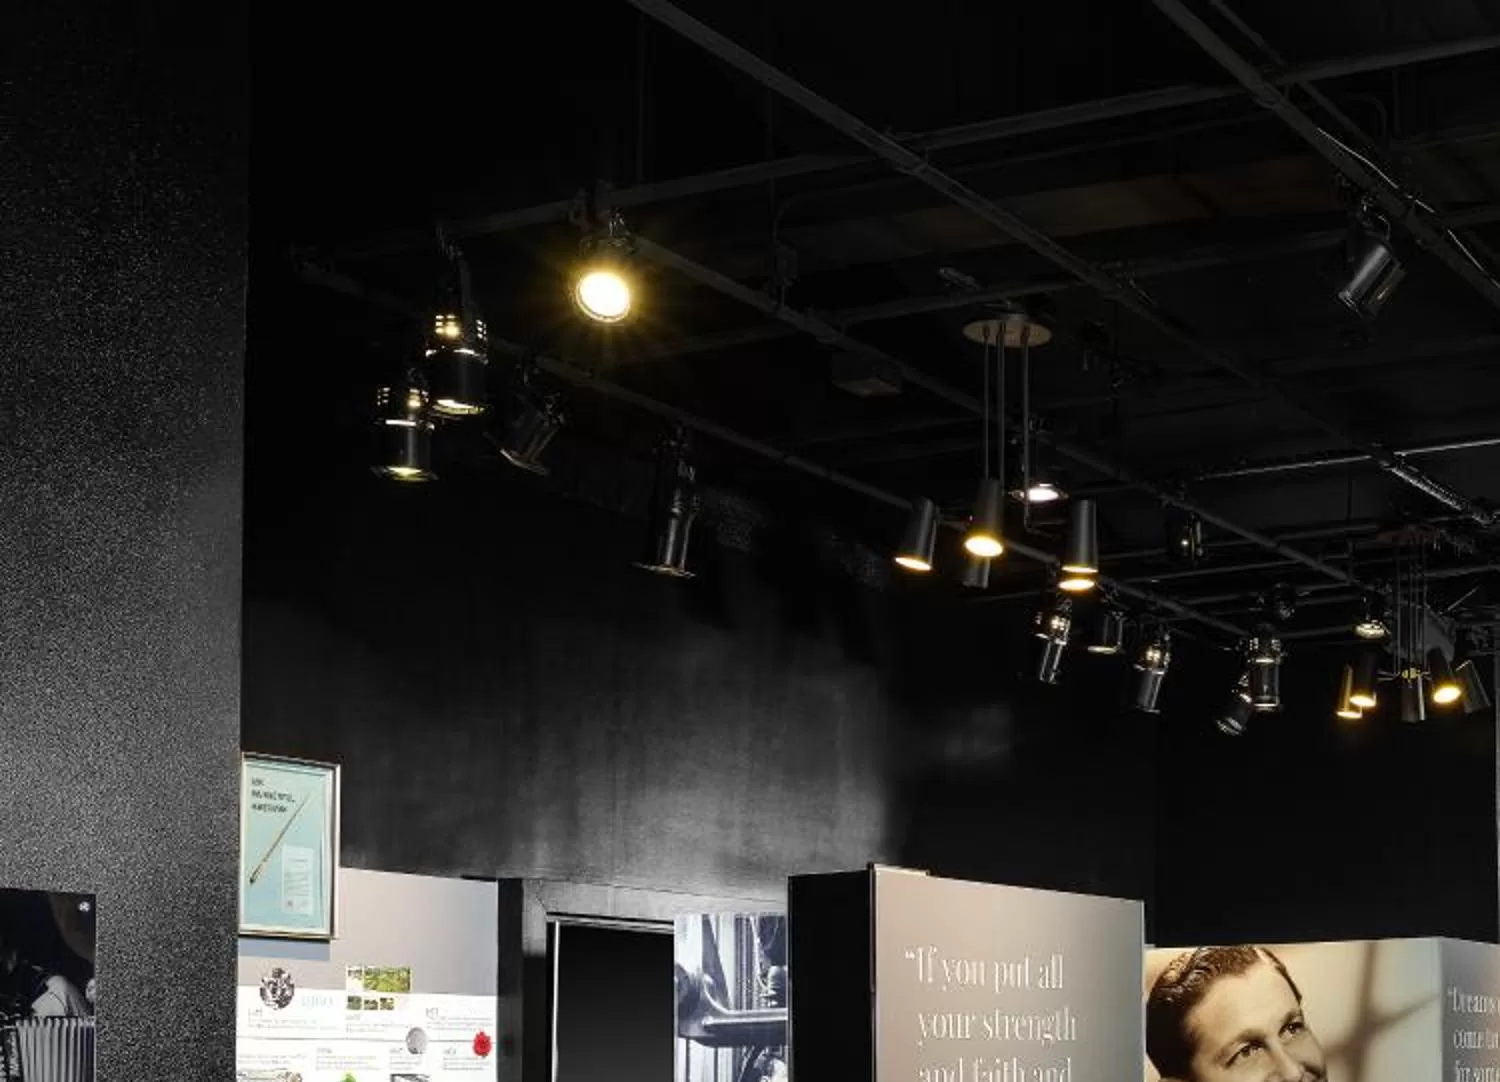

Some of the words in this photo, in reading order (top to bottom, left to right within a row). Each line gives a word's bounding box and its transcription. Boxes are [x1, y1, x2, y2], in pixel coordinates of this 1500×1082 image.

[941, 957, 986, 993] you
[993, 954, 1031, 995] put
[1038, 953, 1065, 991] all
[917, 1010, 977, 1046] your
[982, 1007, 1077, 1046] strength
